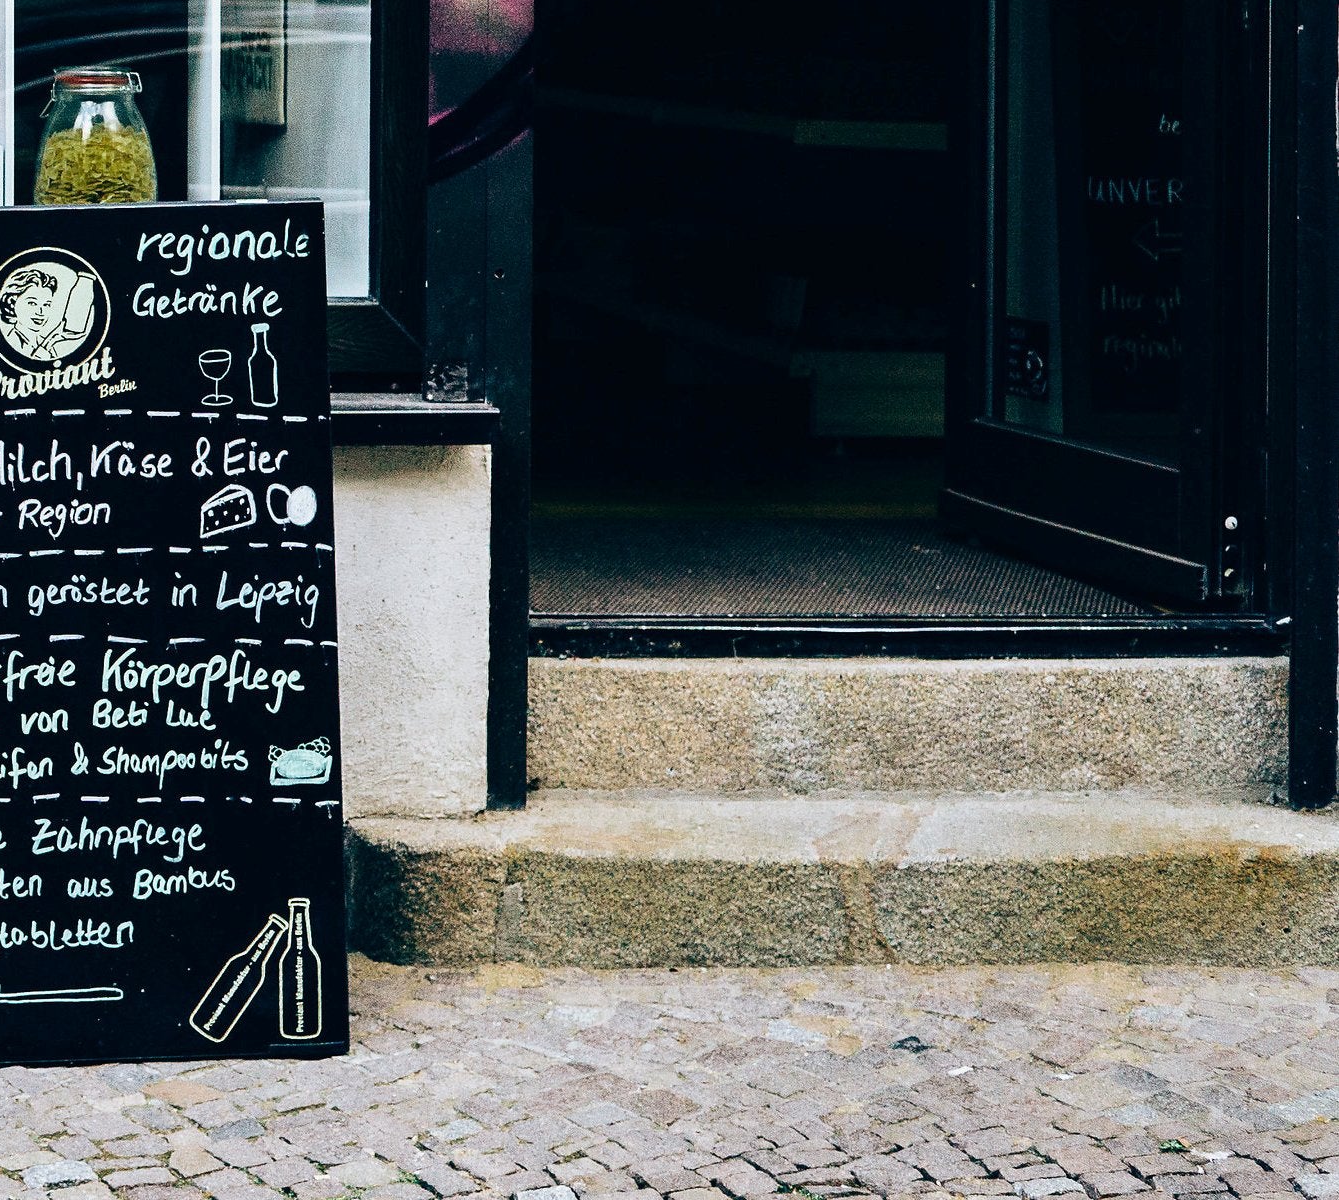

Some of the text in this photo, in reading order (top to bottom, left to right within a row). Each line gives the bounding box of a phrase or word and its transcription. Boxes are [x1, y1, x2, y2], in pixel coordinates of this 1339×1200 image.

[137, 219, 309, 274] regionale
[133, 283, 282, 318] Getränke
[98, 379, 138, 400] Berlin
[89, 440, 174, 481] Käse
[189, 437, 213, 477] &
[221, 442, 290, 476] Eier
[16, 498, 112, 538] Region
[27, 575, 151, 618] geröstet
[170, 573, 197, 607] in
[216, 570, 321, 628] Leipzig
[100, 648, 307, 713] Körperpflege
[20, 707, 70, 734] von
[91, 699, 149, 729] Beti
[69, 746, 91, 777] &
[96, 737, 250, 789] Shampoobits
[31, 817, 208, 866] Zahnpflege
[65, 875, 114, 899] aus
[131, 868, 237, 900] Bambus
